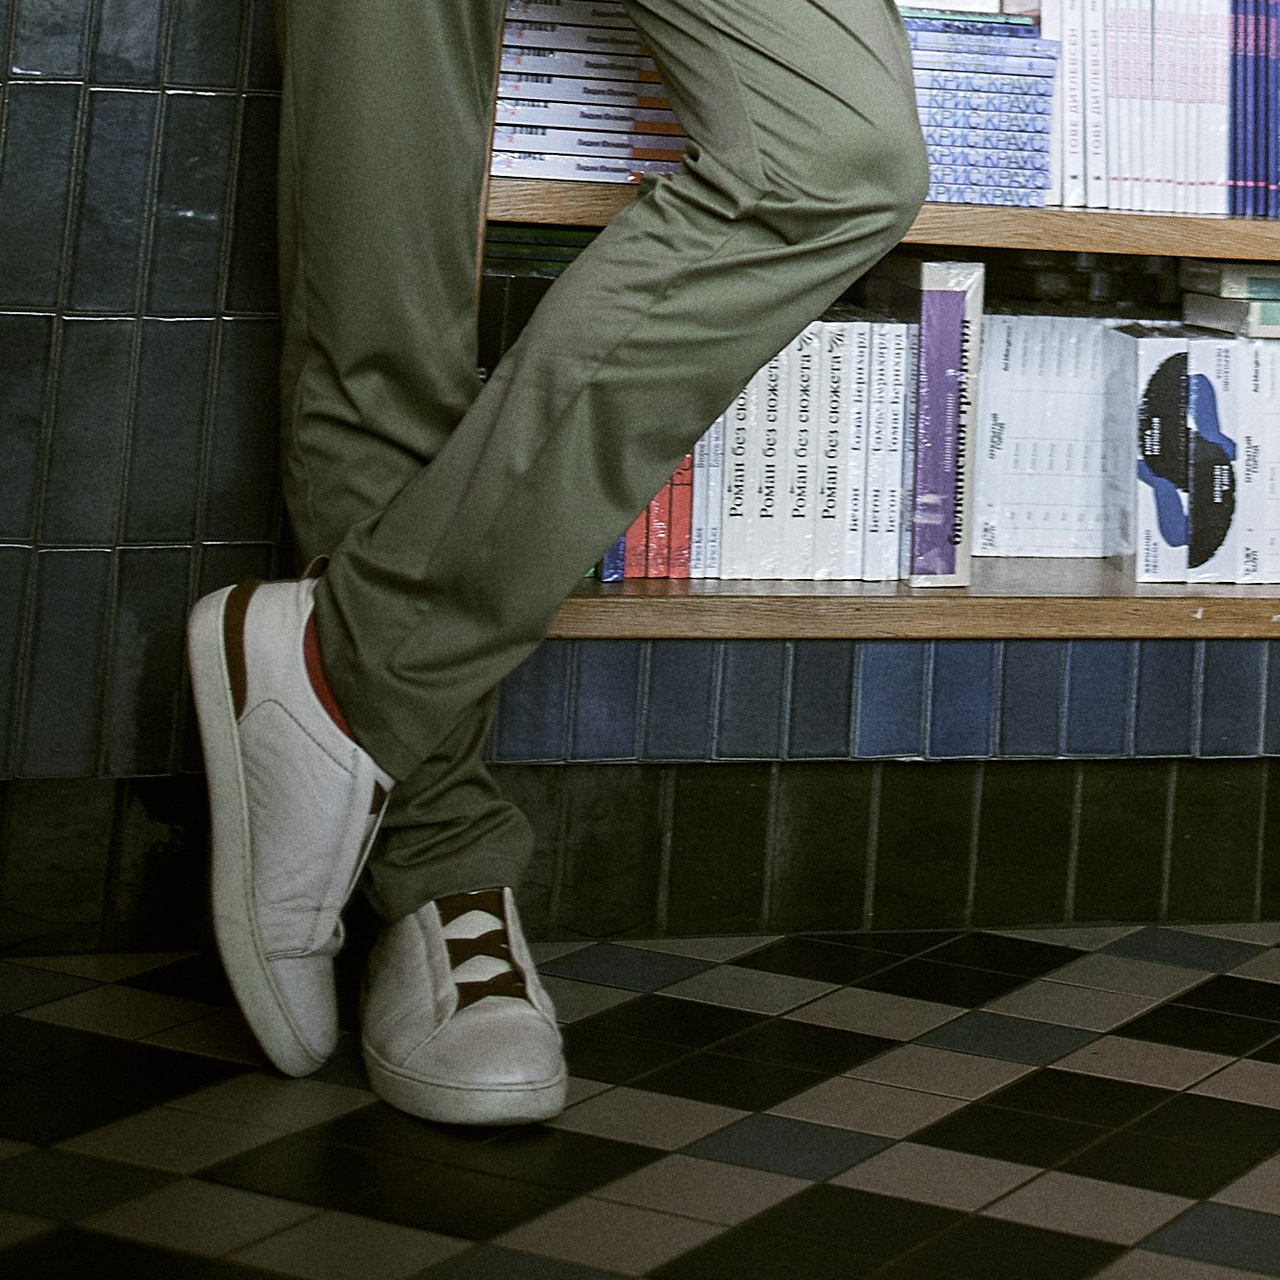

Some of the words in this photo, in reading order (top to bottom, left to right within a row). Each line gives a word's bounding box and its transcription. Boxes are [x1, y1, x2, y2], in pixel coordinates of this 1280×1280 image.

[931, 72, 984, 92] КРИС
[1068, 28, 1079, 114] ДИТЛЕВСЕН
[1090, 29, 1101, 115] ДИТЛЕВСЕН
[928, 108, 983, 130] КРИС
[929, 90, 984, 111] КРИС
[926, 127, 981, 148] КРИС
[928, 147, 981, 167] КРИС
[1069, 121, 1079, 155] ТОВЕ
[1091, 121, 1102, 156] ТОВЕ
[928, 184, 976, 204] КРИС
[930, 166, 983, 186] КРИС
[797, 354, 811, 423] сюжета
[853, 331, 867, 403] Бернхард
[890, 333, 904, 405] Бернхард
[954, 319, 972, 417] трилогия
[736, 387, 748, 421] сюж
[827, 355, 841, 424] сюжета
[733, 427, 746, 456] без
[763, 428, 777, 458] без
[795, 429, 809, 458] без
[824, 430, 839, 459] без
[888, 409, 900, 452] Томас
[729, 463, 746, 517] Роман
[760, 464, 776, 518] Роман
[791, 464, 807, 518] Роман
[822, 465, 838, 519] Роман
[948, 423, 967, 545] балканская
[848, 488, 860, 532] Бетон
[869, 489, 881, 533] Бетон
[885, 489, 897, 534] Бетон
